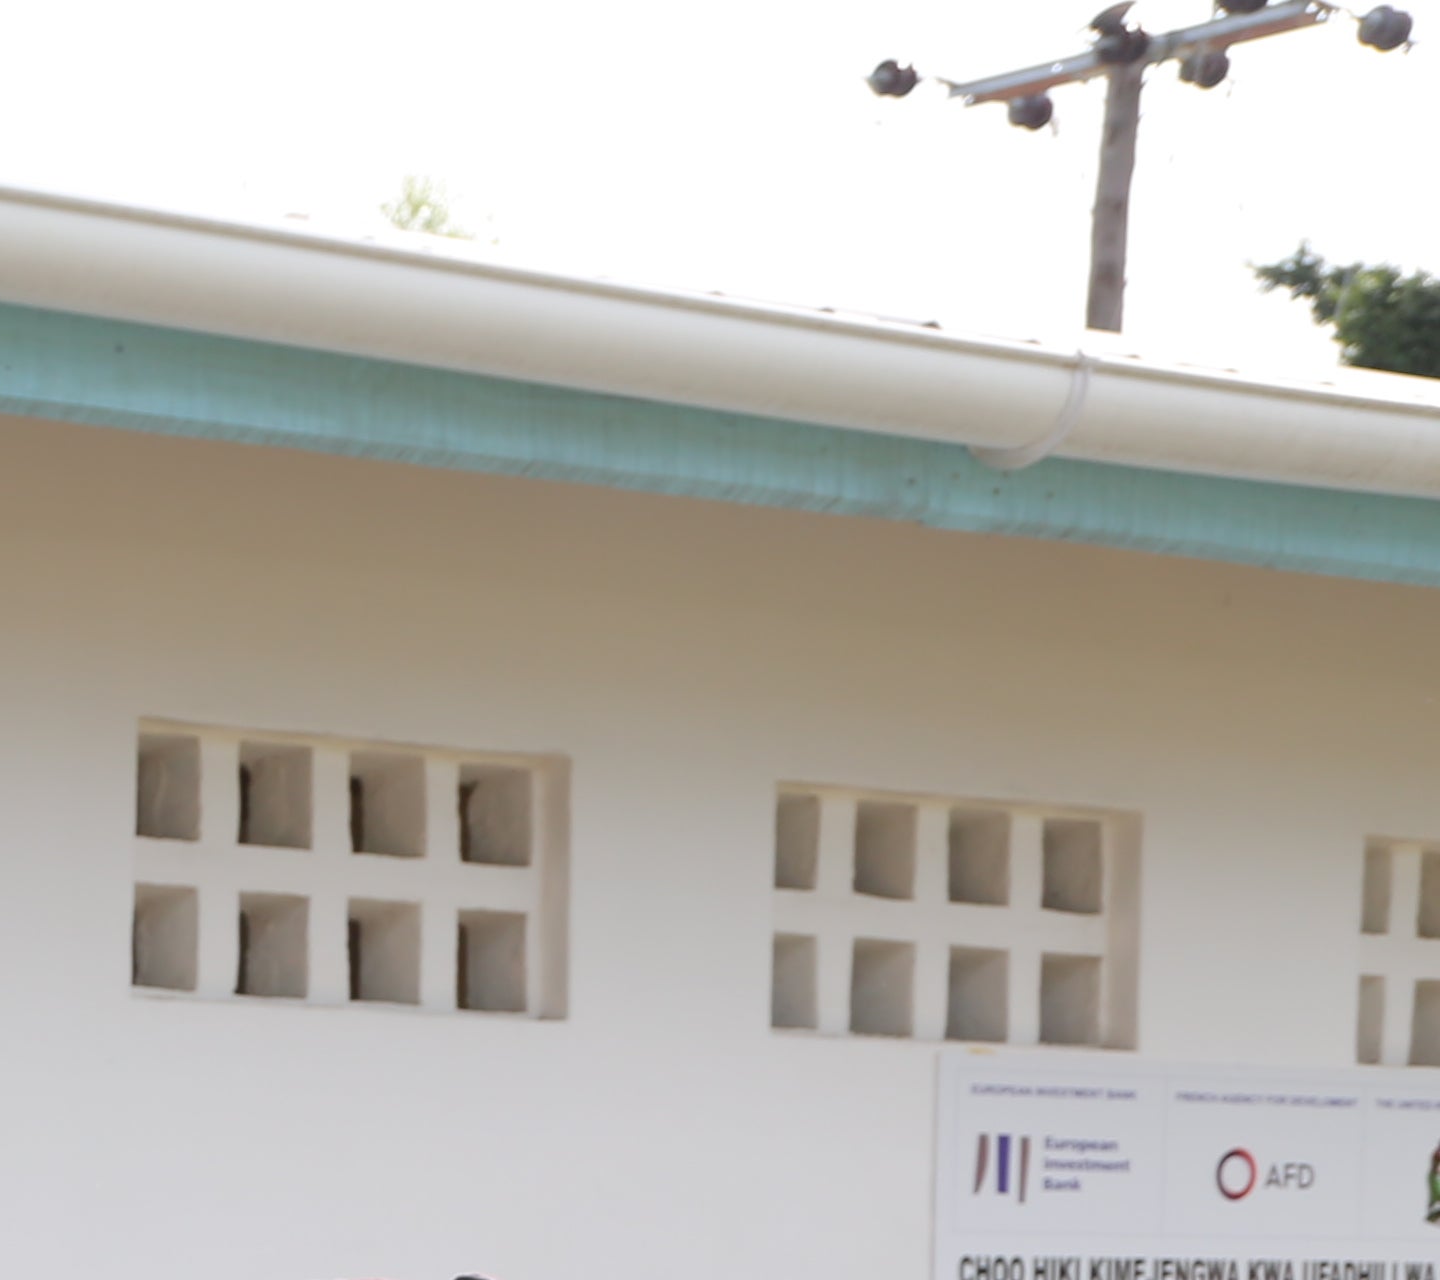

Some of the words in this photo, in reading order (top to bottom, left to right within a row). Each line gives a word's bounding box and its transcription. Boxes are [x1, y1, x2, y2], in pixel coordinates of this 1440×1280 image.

[1045, 1137, 1118, 1153] European
[1043, 1177, 1080, 1190] Bank
[1265, 1163, 1315, 1189] AFD
